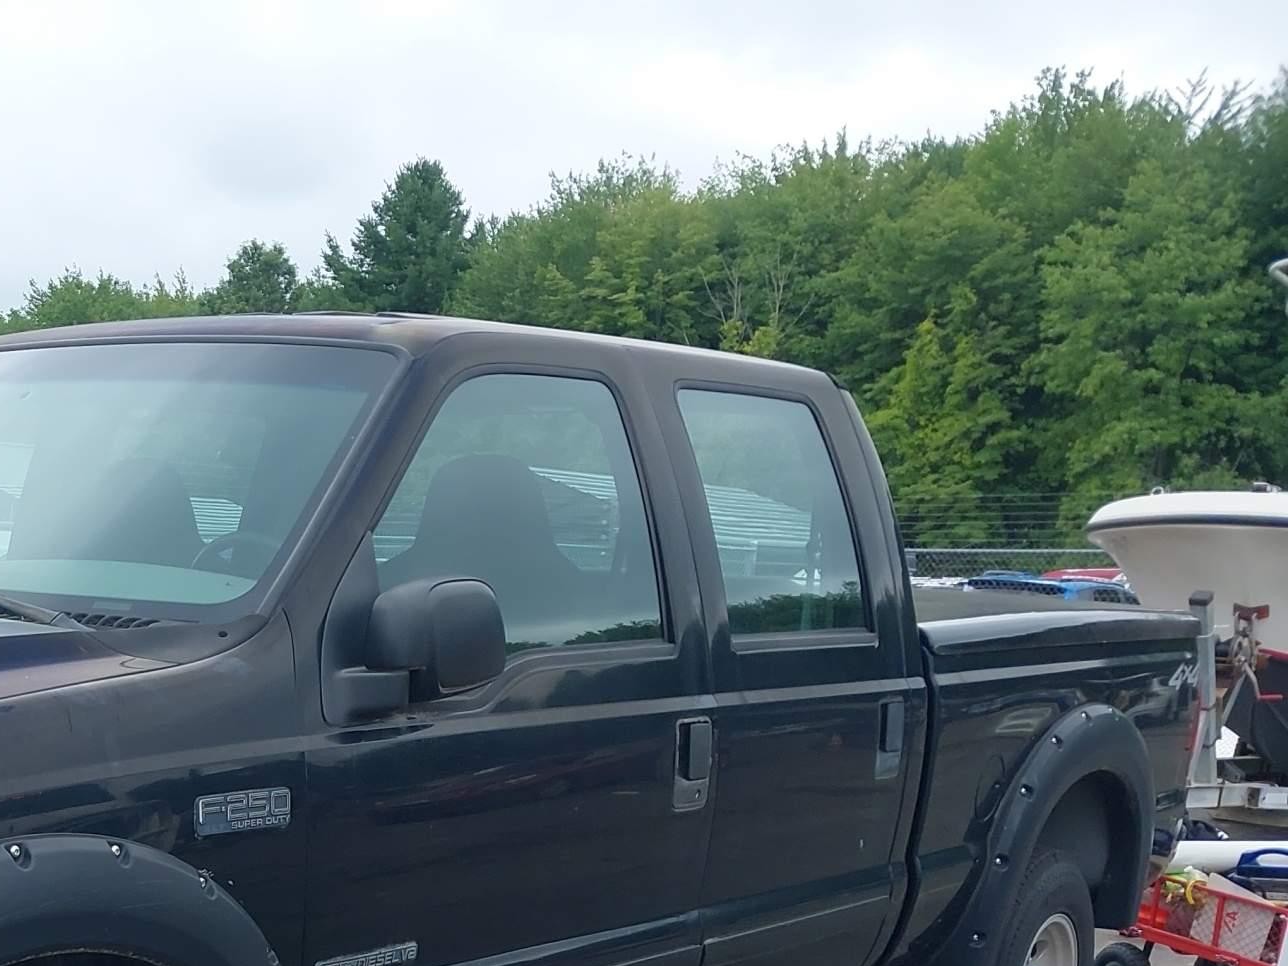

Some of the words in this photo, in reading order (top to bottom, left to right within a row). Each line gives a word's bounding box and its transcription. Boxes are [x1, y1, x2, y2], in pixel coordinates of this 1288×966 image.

[231, 818, 263, 829] SUPER
[265, 814, 291, 825] DUTY
[401, 945, 418, 961] V8
